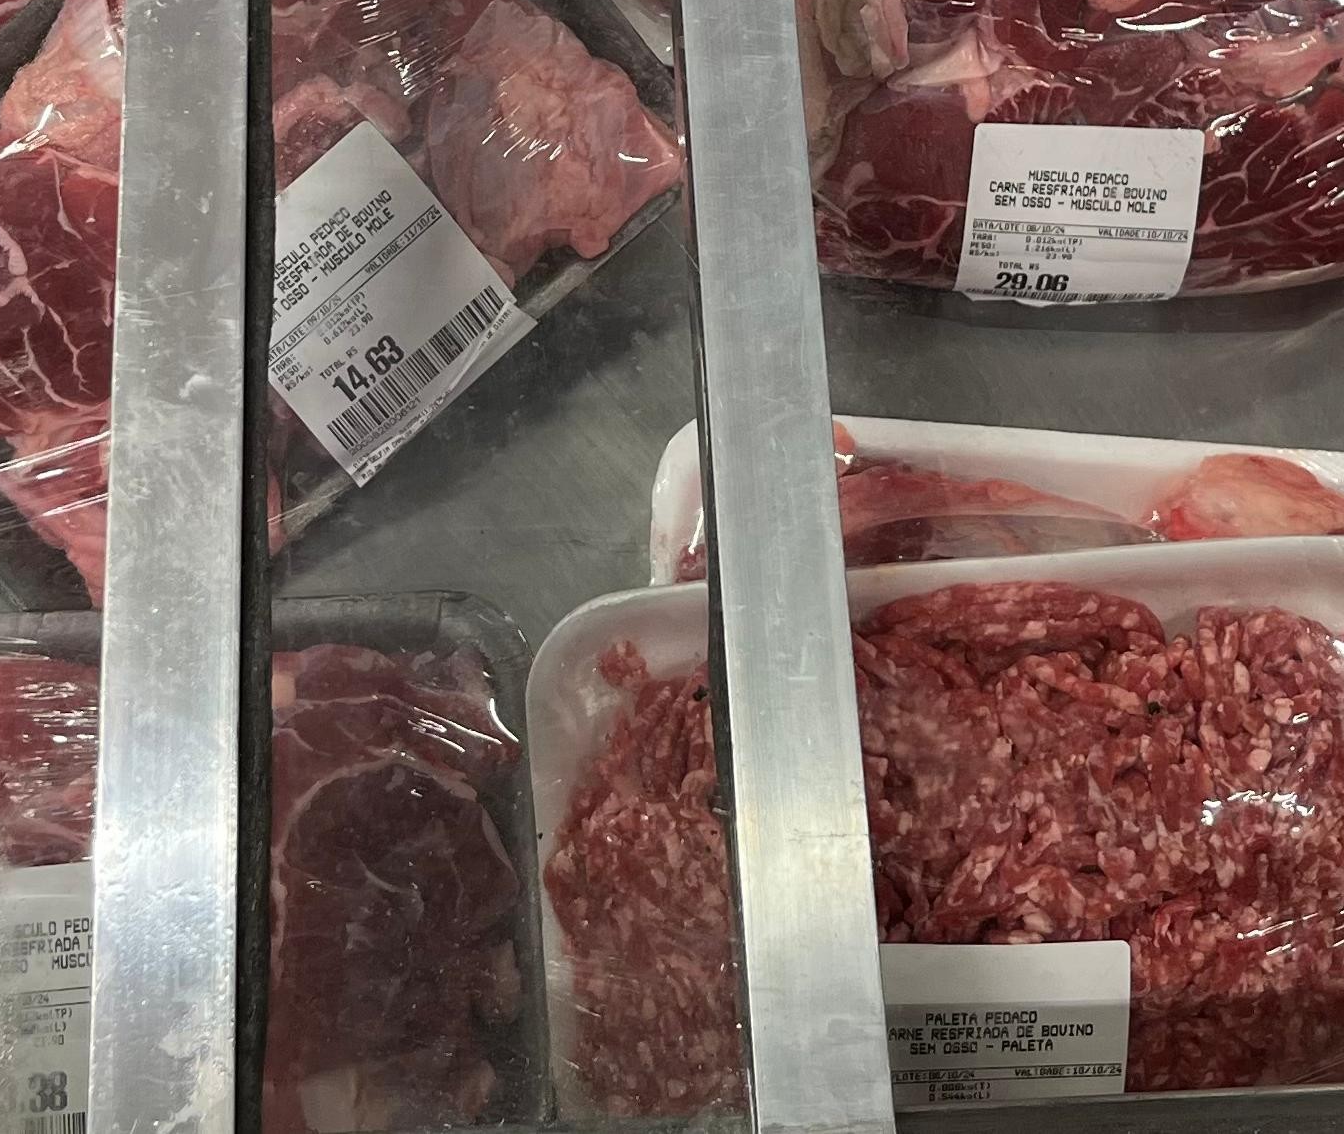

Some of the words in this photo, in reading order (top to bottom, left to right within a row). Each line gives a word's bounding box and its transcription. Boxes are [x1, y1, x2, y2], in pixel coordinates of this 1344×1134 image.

[1028, 170, 1079, 183] MUSCULO
[1085, 172, 1129, 185] PEDACO
[990, 181, 1025, 194] CARNE
[1032, 184, 1097, 197] RESFRIADA
[1103, 187, 1117, 198] DE
[1124, 187, 1167, 201] BOVINO
[995, 196, 1016, 207] SEM
[1022, 197, 1051, 209] OSSO
[1071, 199, 1121, 212] MUSCULO
[1128, 201, 1156, 213] MOLE
[269, 241, 311, 279] USCULO
[308, 205, 352, 245] PEDACO
[275, 238, 337, 294] RESFRIADA
[334, 224, 353, 243] DE
[350, 189, 393, 228] BOVINO
[278, 282, 310, 311] OSSO
[317, 231, 368, 277] MUSCULO
[364, 206, 395, 235] MOLE
[999, 261, 1023, 270] TOTAL
[318, 356, 345, 381] TOTAL
[329, 332, 407, 405] 14,63
[52, 952, 92, 970] MUSCU
[926, 1012, 978, 1025] PALETA
[985, 1011, 1038, 1024] PEDACO
[888, 1028, 923, 1042] ARNE
[931, 1026, 1010, 1041] RESFRIADA
[1017, 1025, 1033, 1038] DE
[1042, 1024, 1094, 1037] BOVINO
[910, 1042, 936, 1055] SEM
[944, 1041, 978, 1054] OSSO
[1002, 1039, 1053, 1052] PALETA
